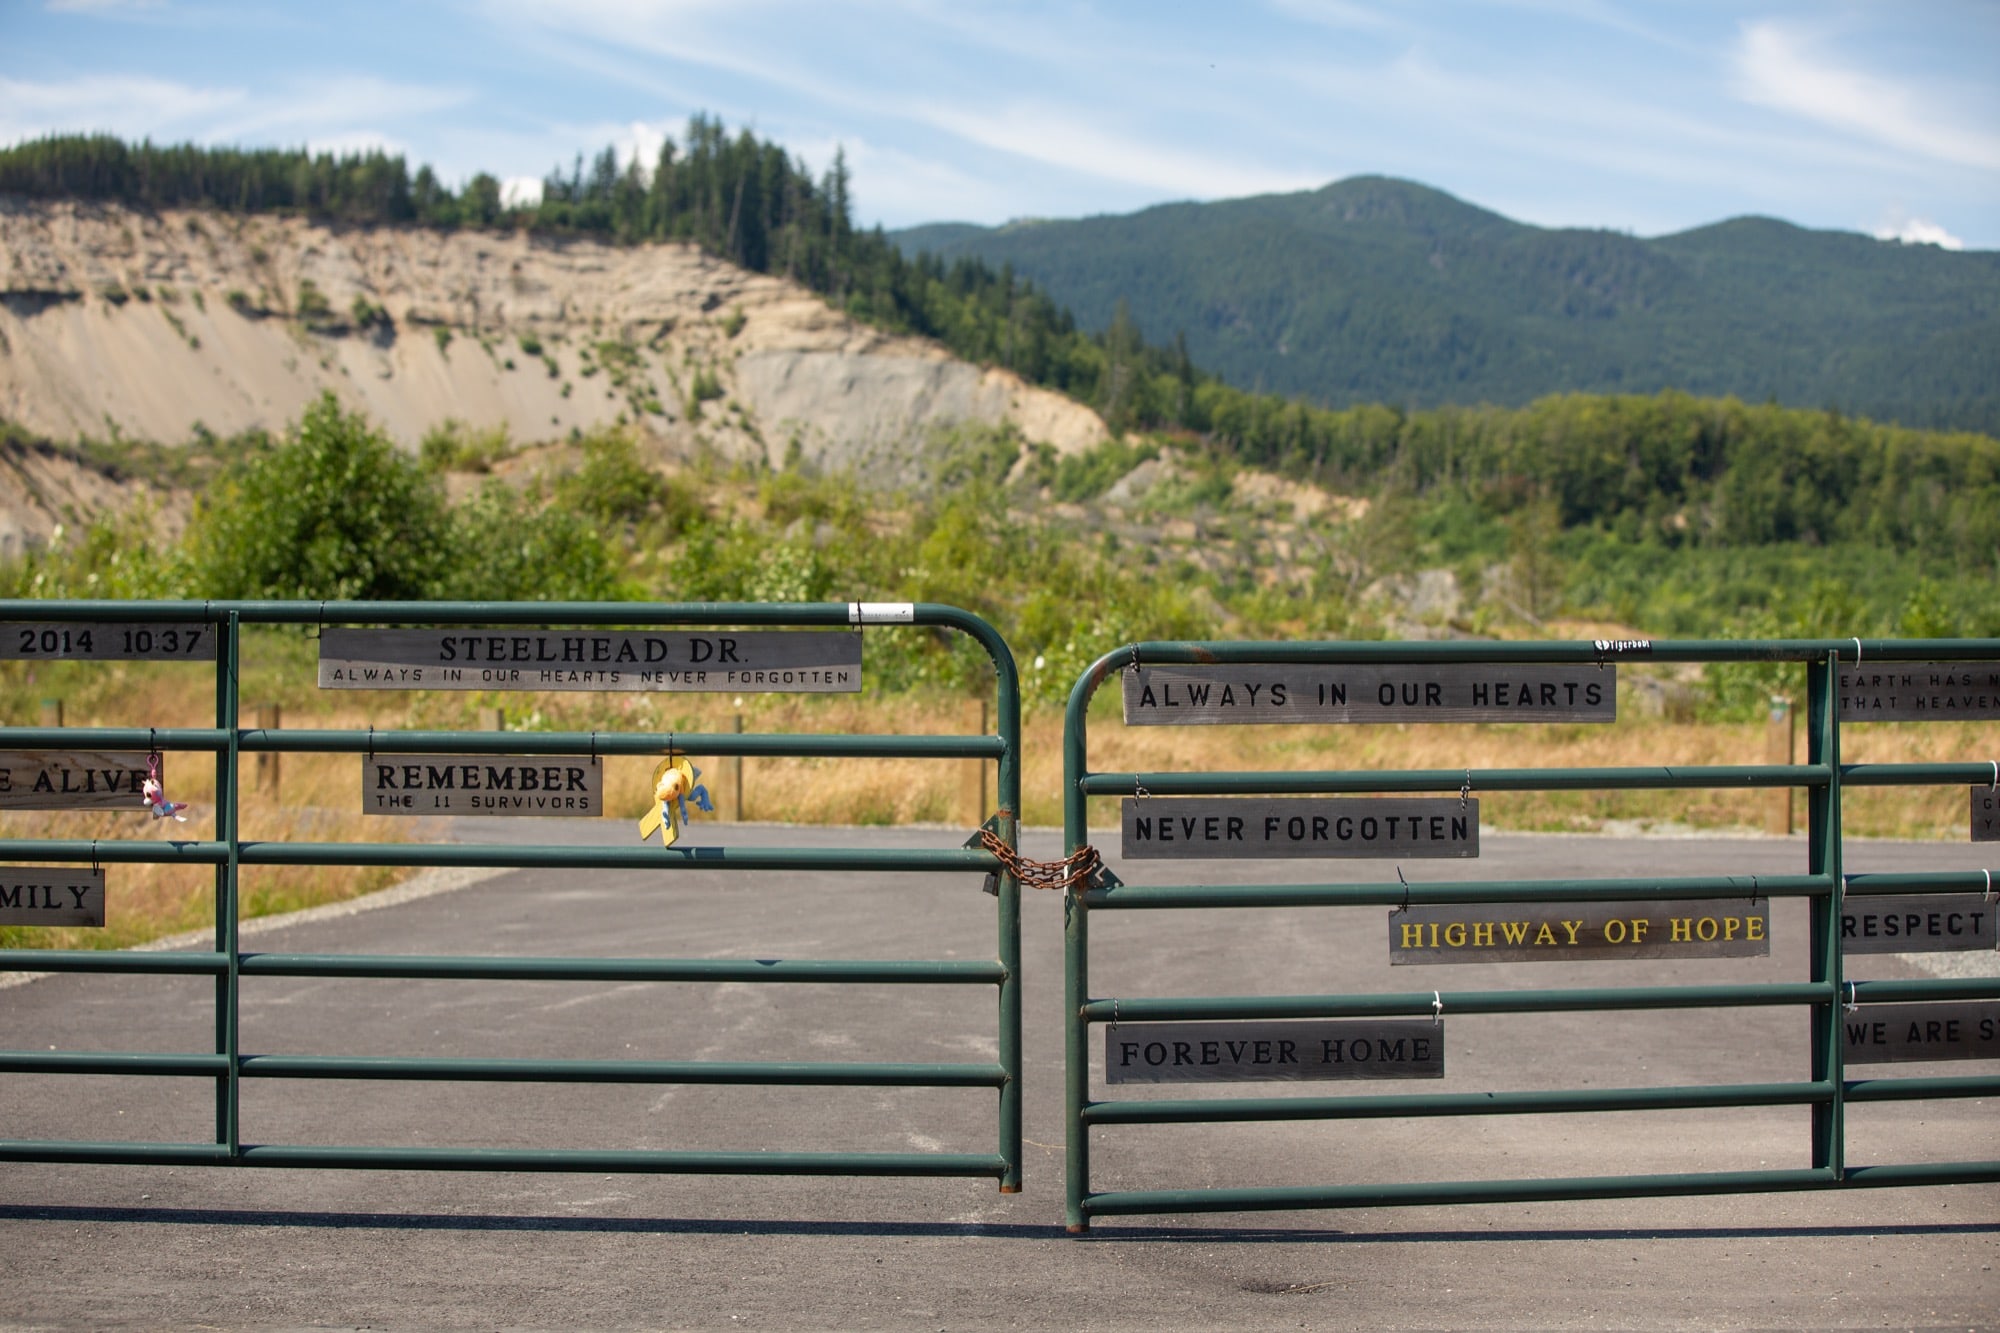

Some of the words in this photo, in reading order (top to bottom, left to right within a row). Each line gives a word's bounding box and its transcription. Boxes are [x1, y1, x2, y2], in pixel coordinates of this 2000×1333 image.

[19, 629, 94, 653] 2014
[123, 630, 202, 653] 10:37
[440, 637, 668, 663] STEELHEAD
[690, 639, 749, 663] DR.
[333, 669, 423, 681] ALWAYS
[443, 670, 461, 681] IN
[483, 670, 520, 682] OUR
[540, 671, 620, 683] HEARTS
[641, 671, 707, 683] NEVER
[728, 671, 848, 684] FORGOTTEN
[1841, 675, 1912, 687] EARTH
[1930, 675, 1972, 686] HAS
[1140, 683, 1287, 707] ALWAYS
[1318, 683, 1347, 705] IN
[1378, 683, 1442, 705] OUR
[1472, 683, 1602, 706] HEARTS
[1842, 697, 1897, 709] THAT
[1917, 696, 2000, 708] HEAVEN
[32, 768, 149, 793] ALIVE
[376, 765, 588, 791] REMEMBER
[377, 795, 413, 807] THE
[435, 796, 450, 807] 11
[471, 796, 589, 808] SURVIVORS
[1136, 816, 1245, 840] NEVER
[1265, 815, 1468, 840] FORGOTTEN
[0, 885, 91, 909] MILY
[1400, 920, 1584, 949] HIGHWAY
[1604, 919, 1649, 943] OF
[1670, 917, 1765, 941] HOPE
[1841, 912, 1984, 938] RESPECT
[1846, 1022, 1886, 1046] WE
[1907, 1020, 1960, 1043] ARE
[1120, 1041, 1298, 1066] FOREVER
[1322, 1037, 1432, 1062] HOME
